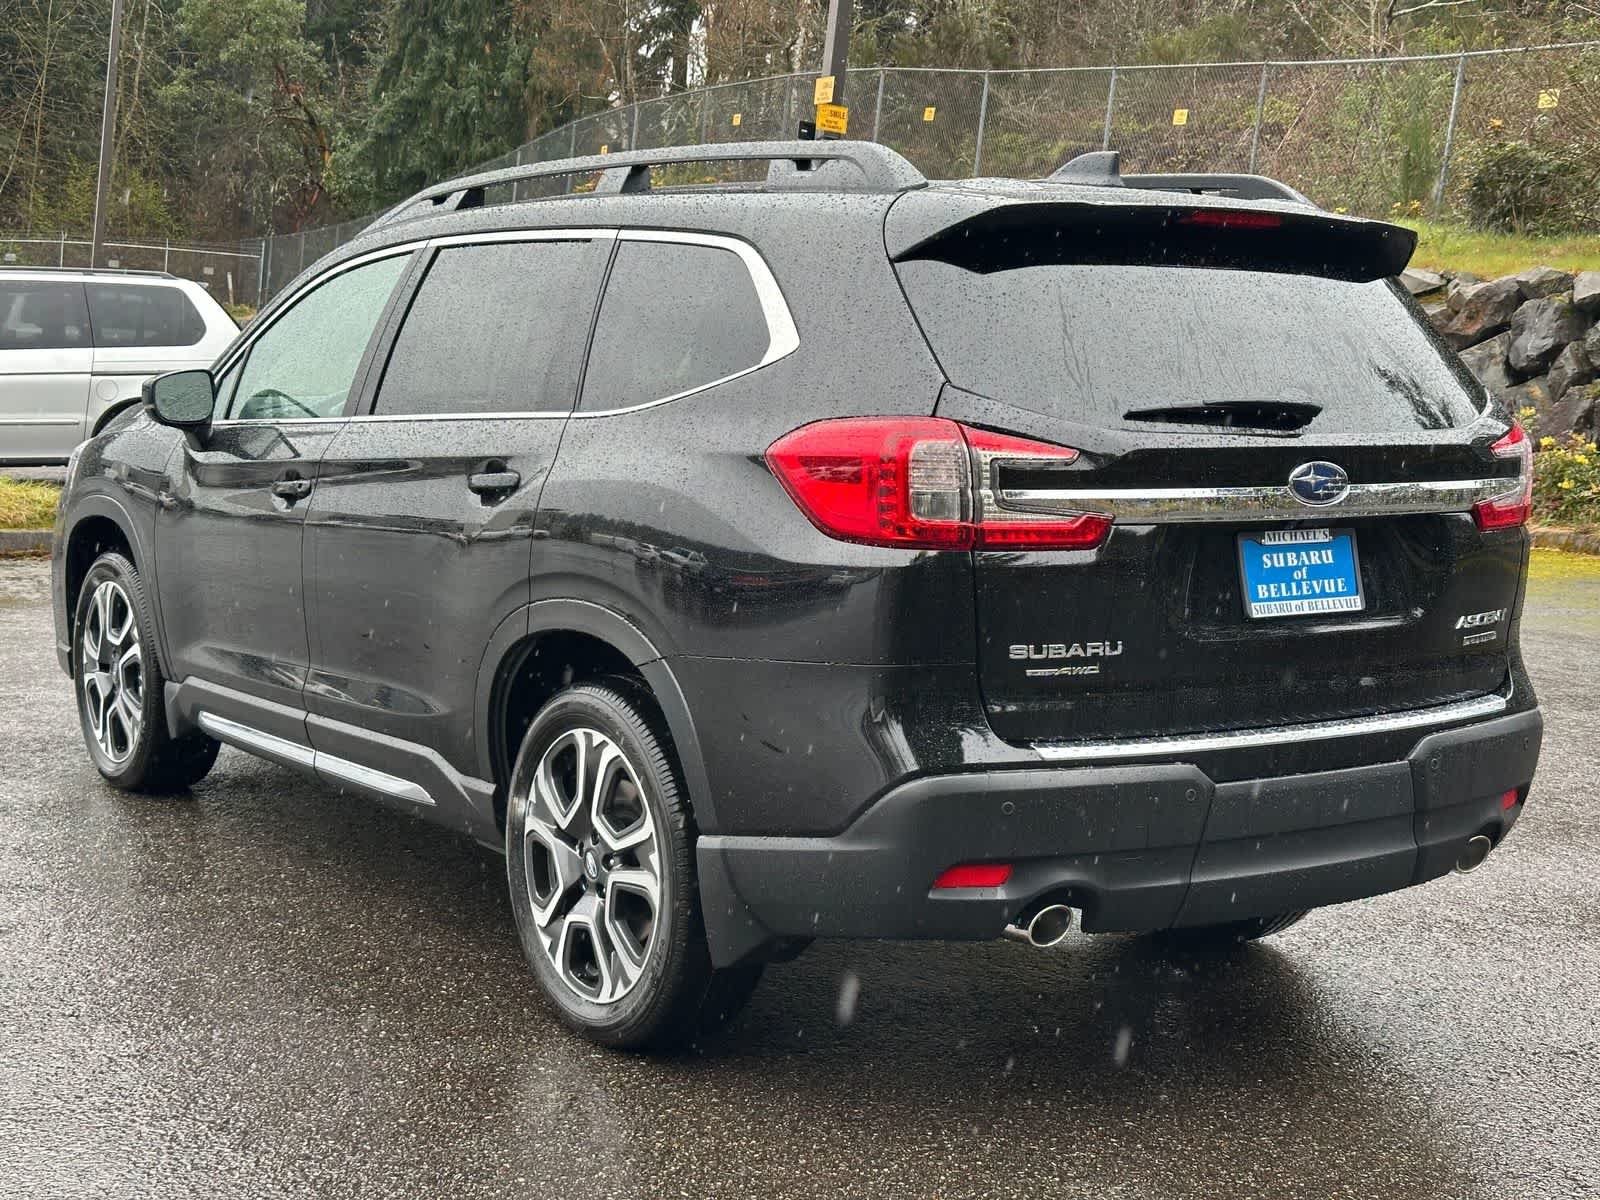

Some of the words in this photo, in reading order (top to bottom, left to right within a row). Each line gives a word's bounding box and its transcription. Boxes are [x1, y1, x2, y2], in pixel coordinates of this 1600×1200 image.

[1262, 550, 1334, 569] SUBARU
[1293, 566, 1308, 580] of
[1257, 578, 1347, 599] BELLEVUE
[1253, 602, 1293, 616] SUBARU
[1294, 601, 1305, 612] of
[1308, 597, 1360, 610] BELLEVUE
[1008, 640, 1123, 659] SUBARU
